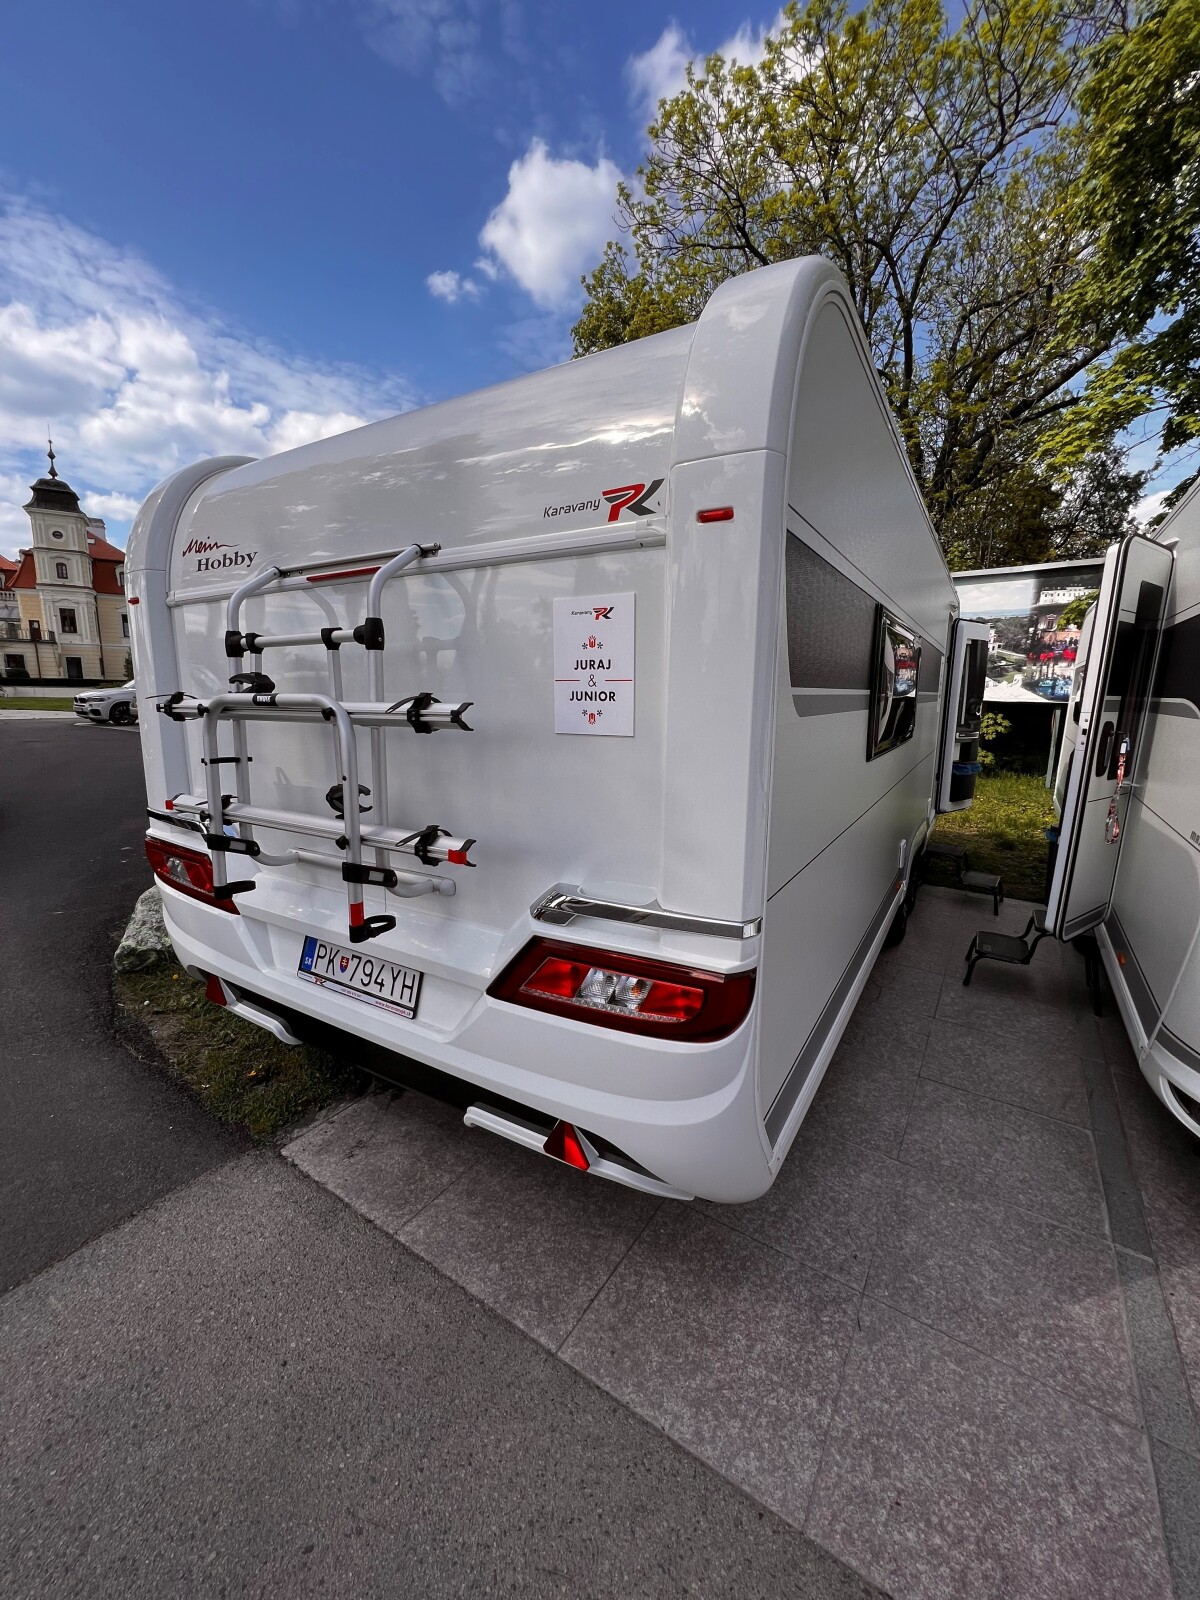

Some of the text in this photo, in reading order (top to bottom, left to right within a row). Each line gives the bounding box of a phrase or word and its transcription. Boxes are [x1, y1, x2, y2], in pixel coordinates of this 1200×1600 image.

[543, 499, 601, 518] Karavany
[182, 536, 240, 557] Mein
[196, 550, 258, 572] Hobby
[574, 659, 611, 670] JURAJ
[588, 674, 597, 687] &
[569, 691, 616, 702] JUNIOR
[304, 956, 312, 965] SK
[349, 953, 416, 1003] 794YH
